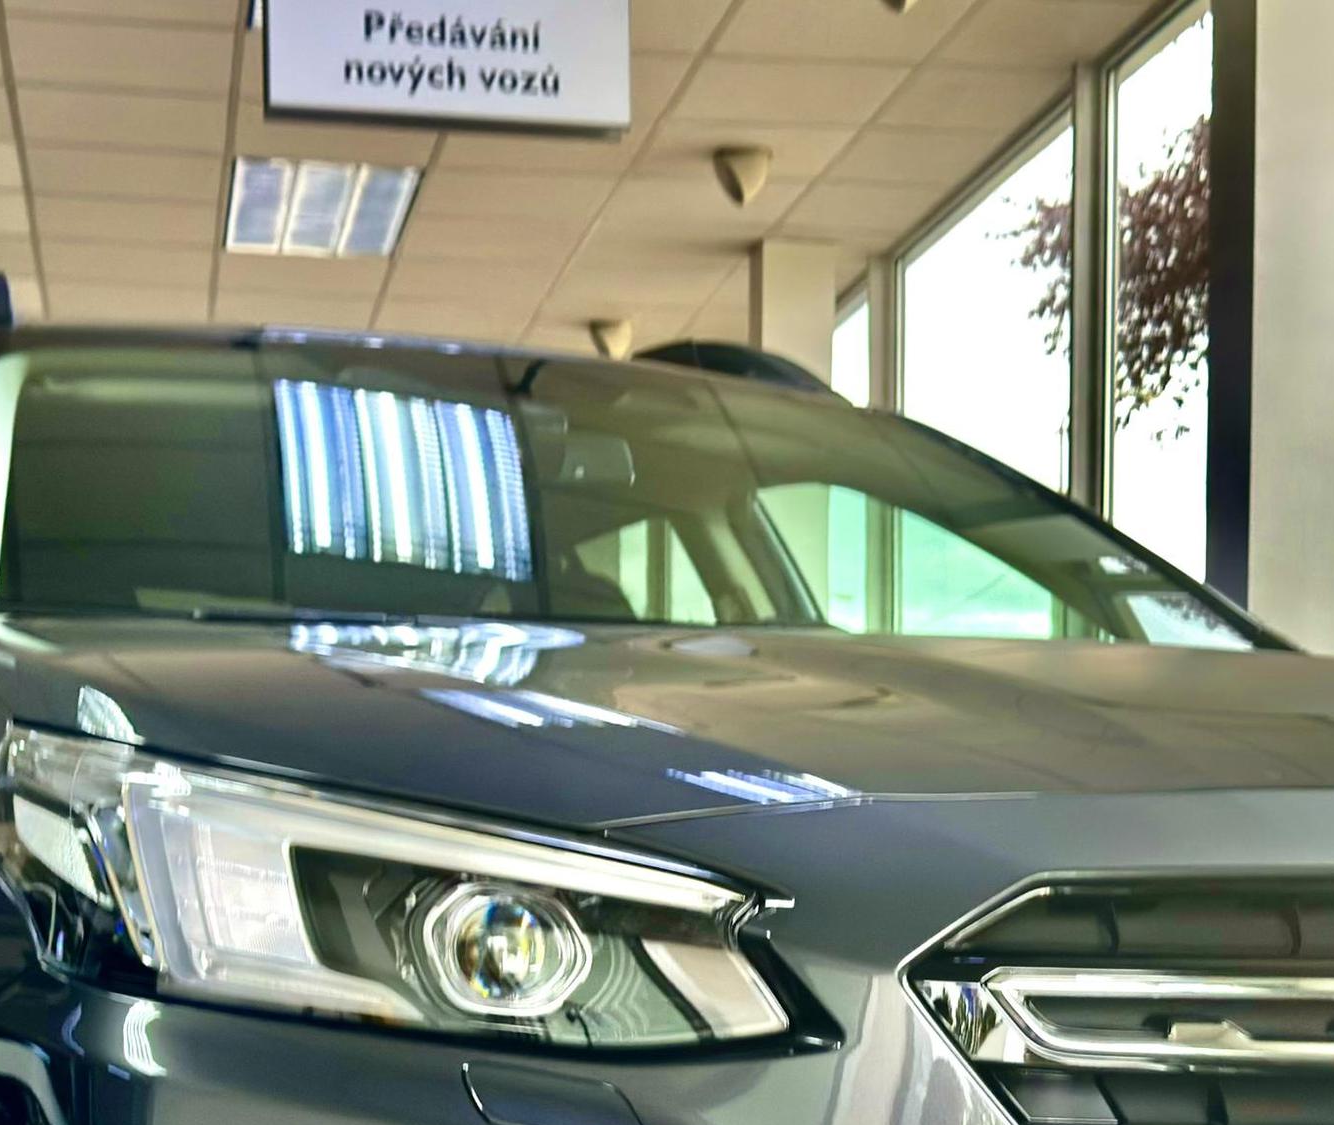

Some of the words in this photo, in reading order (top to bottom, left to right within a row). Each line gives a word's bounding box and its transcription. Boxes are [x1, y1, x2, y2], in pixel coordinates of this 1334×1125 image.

[364, 9, 540, 52] Předávání
[344, 55, 466, 98] nových
[479, 63, 560, 97] vozů
